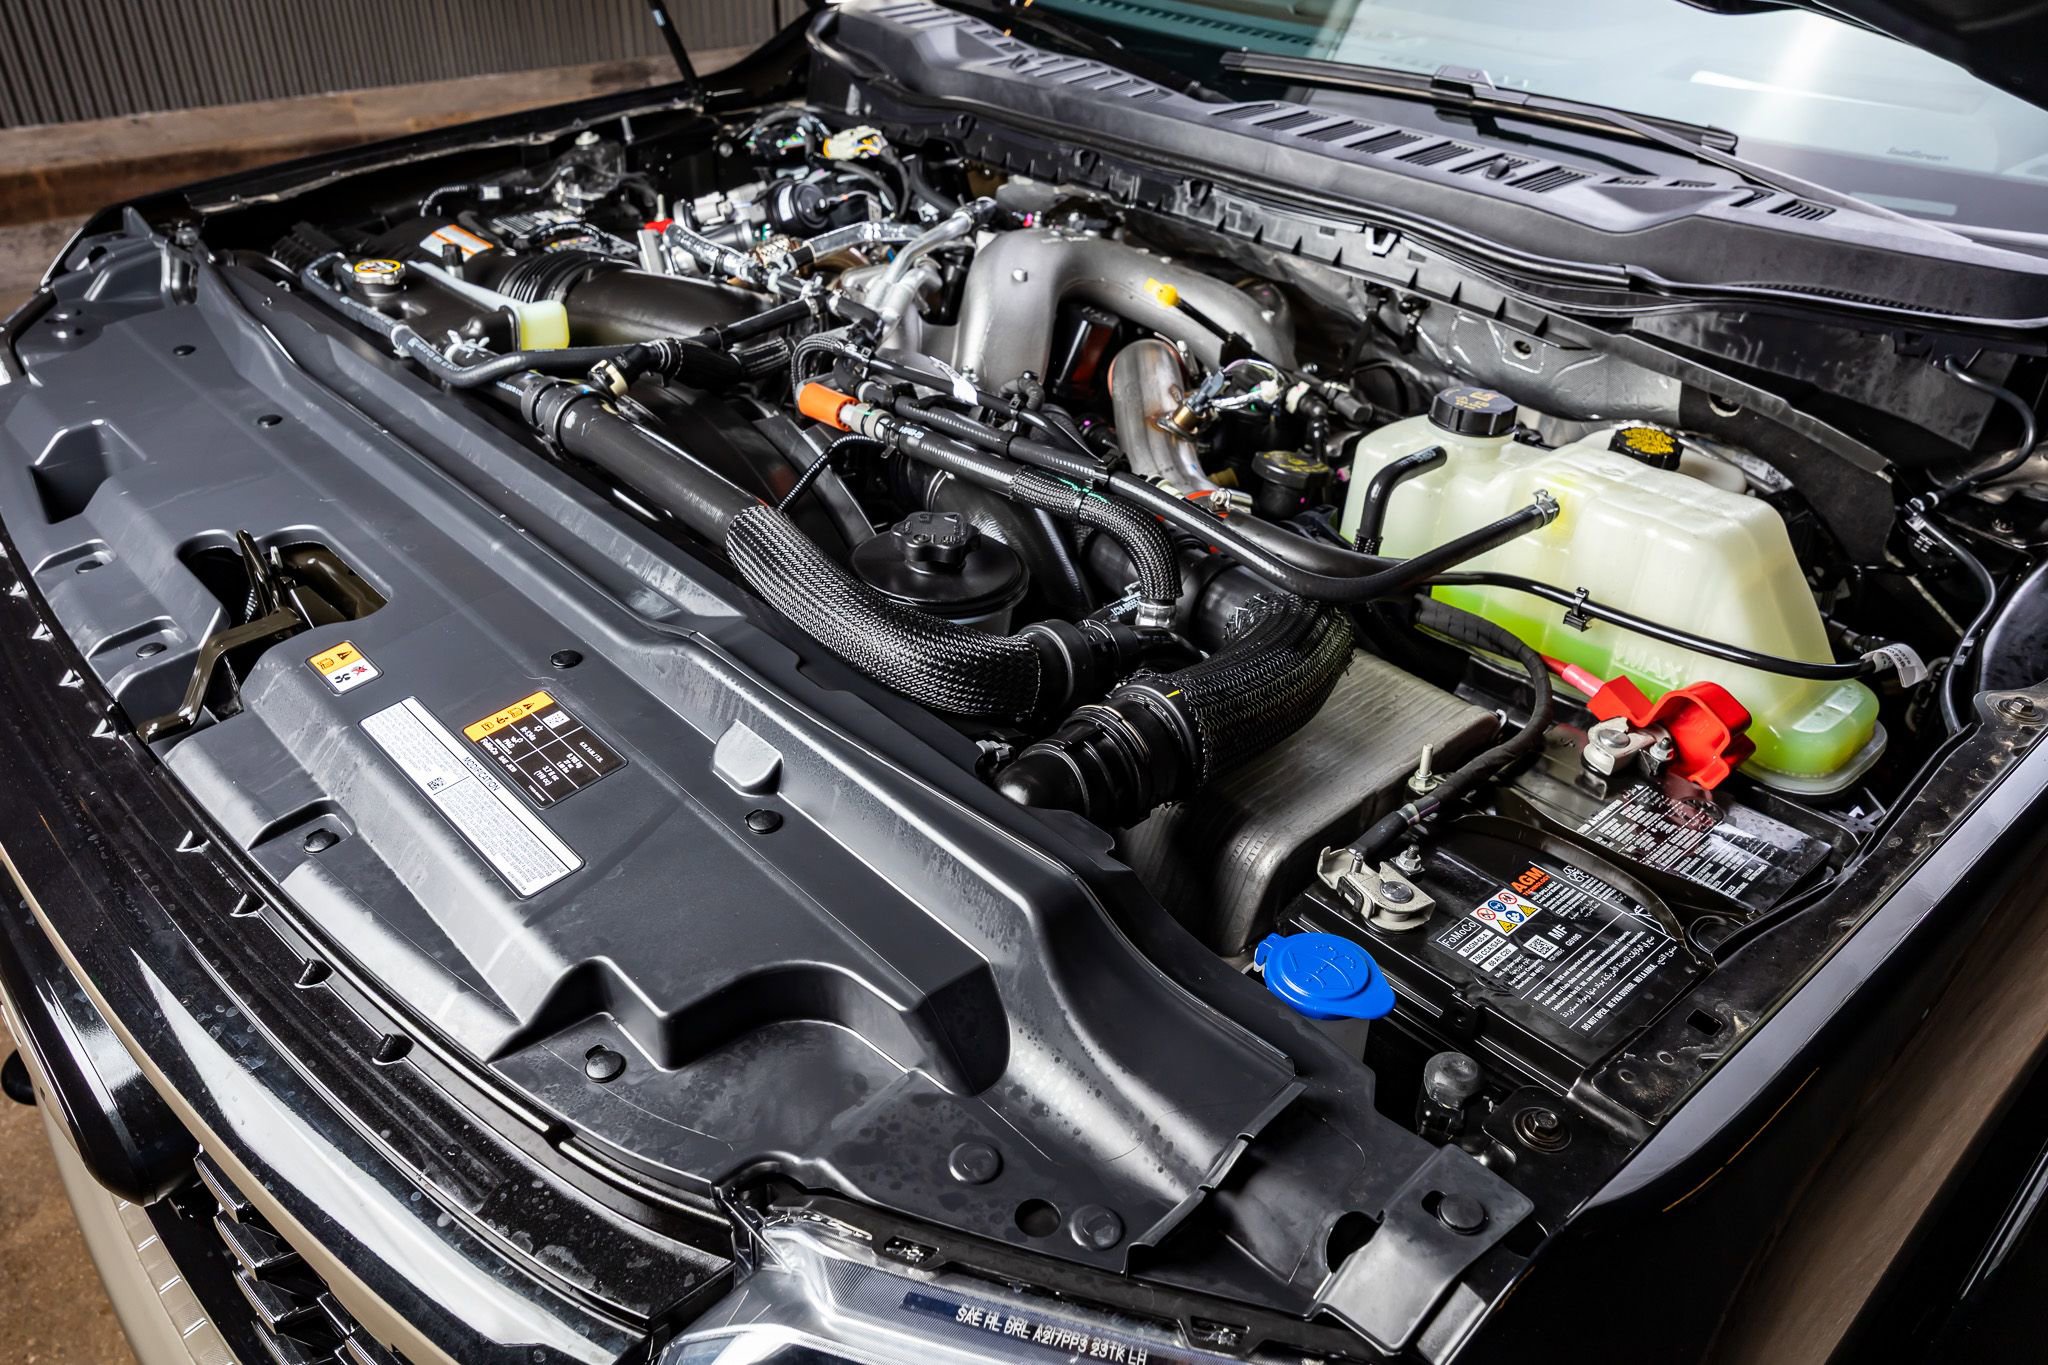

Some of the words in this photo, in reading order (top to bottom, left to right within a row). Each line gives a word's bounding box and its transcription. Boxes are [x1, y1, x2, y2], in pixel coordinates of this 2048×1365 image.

[464, 757, 500, 791] MODIFICATION
[1512, 867, 1544, 893] AGM
[1442, 922, 1476, 947] FoMoCo
[1548, 924, 1567, 940] MF
[1587, 1016, 1599, 1026] NOT
[955, 1306, 982, 1327] SAE
[984, 1312, 1001, 1332] HL
[1004, 1318, 1030, 1340] DRL
[1128, 1347, 1148, 1365] LH
